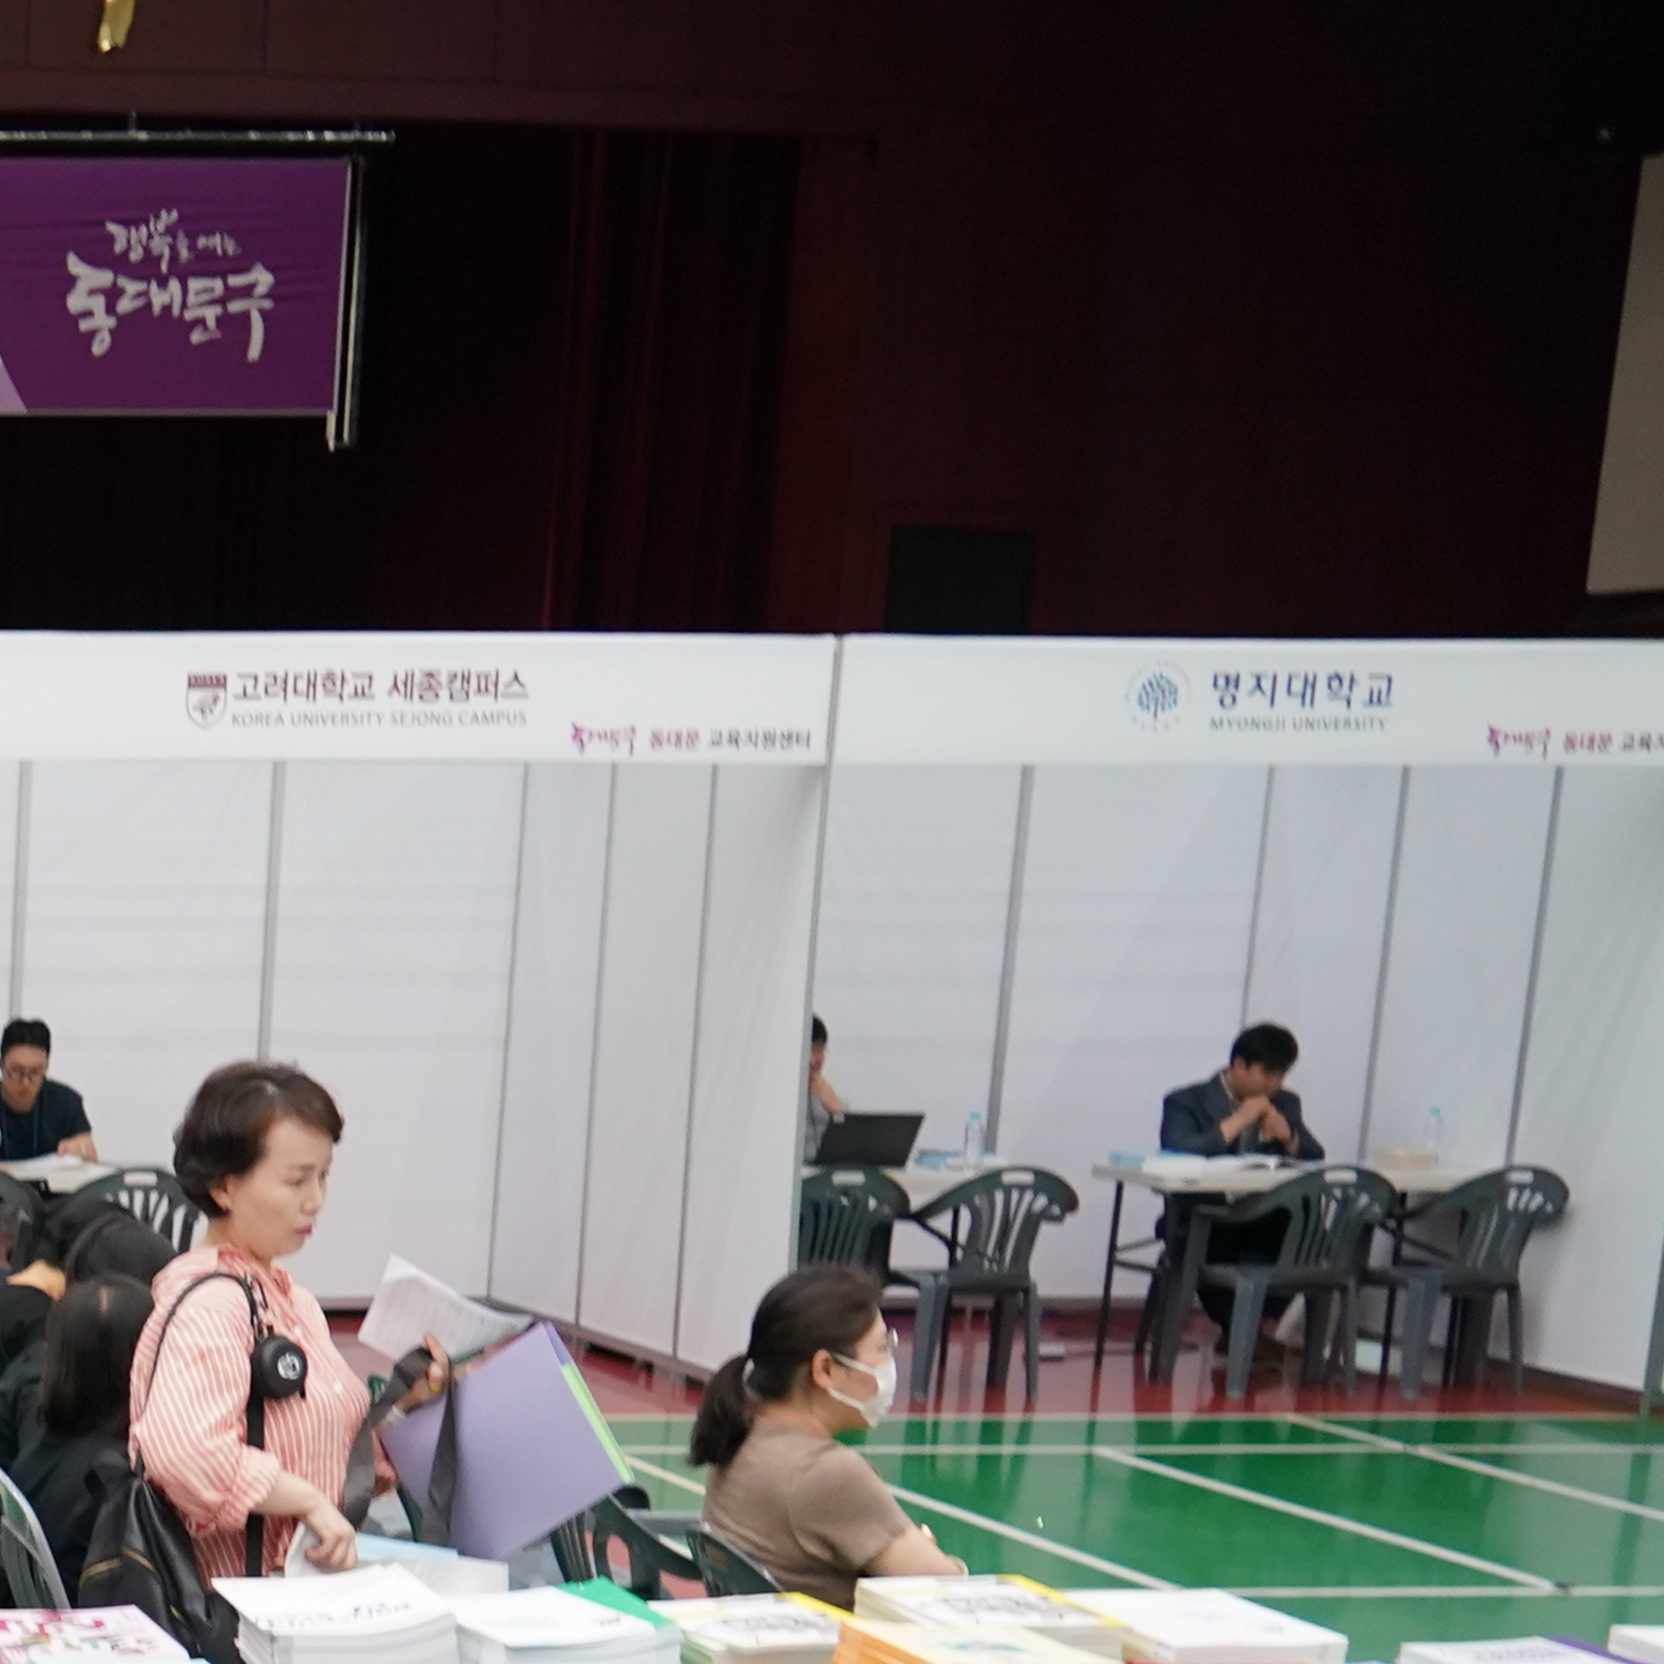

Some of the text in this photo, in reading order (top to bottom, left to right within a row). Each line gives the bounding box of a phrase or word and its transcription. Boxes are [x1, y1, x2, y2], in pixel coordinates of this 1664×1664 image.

[65, 249, 275, 362] 동대문구
[235, 669, 526, 703] 고려대학교 세종캠퍼스
[1212, 671, 1393, 710] 명지대학교
[231, 710, 527, 727] KOREA UNIVERSITY SEJONG CAMPUS
[1210, 716, 1385, 731] MYONGJI UNIVERSITY
